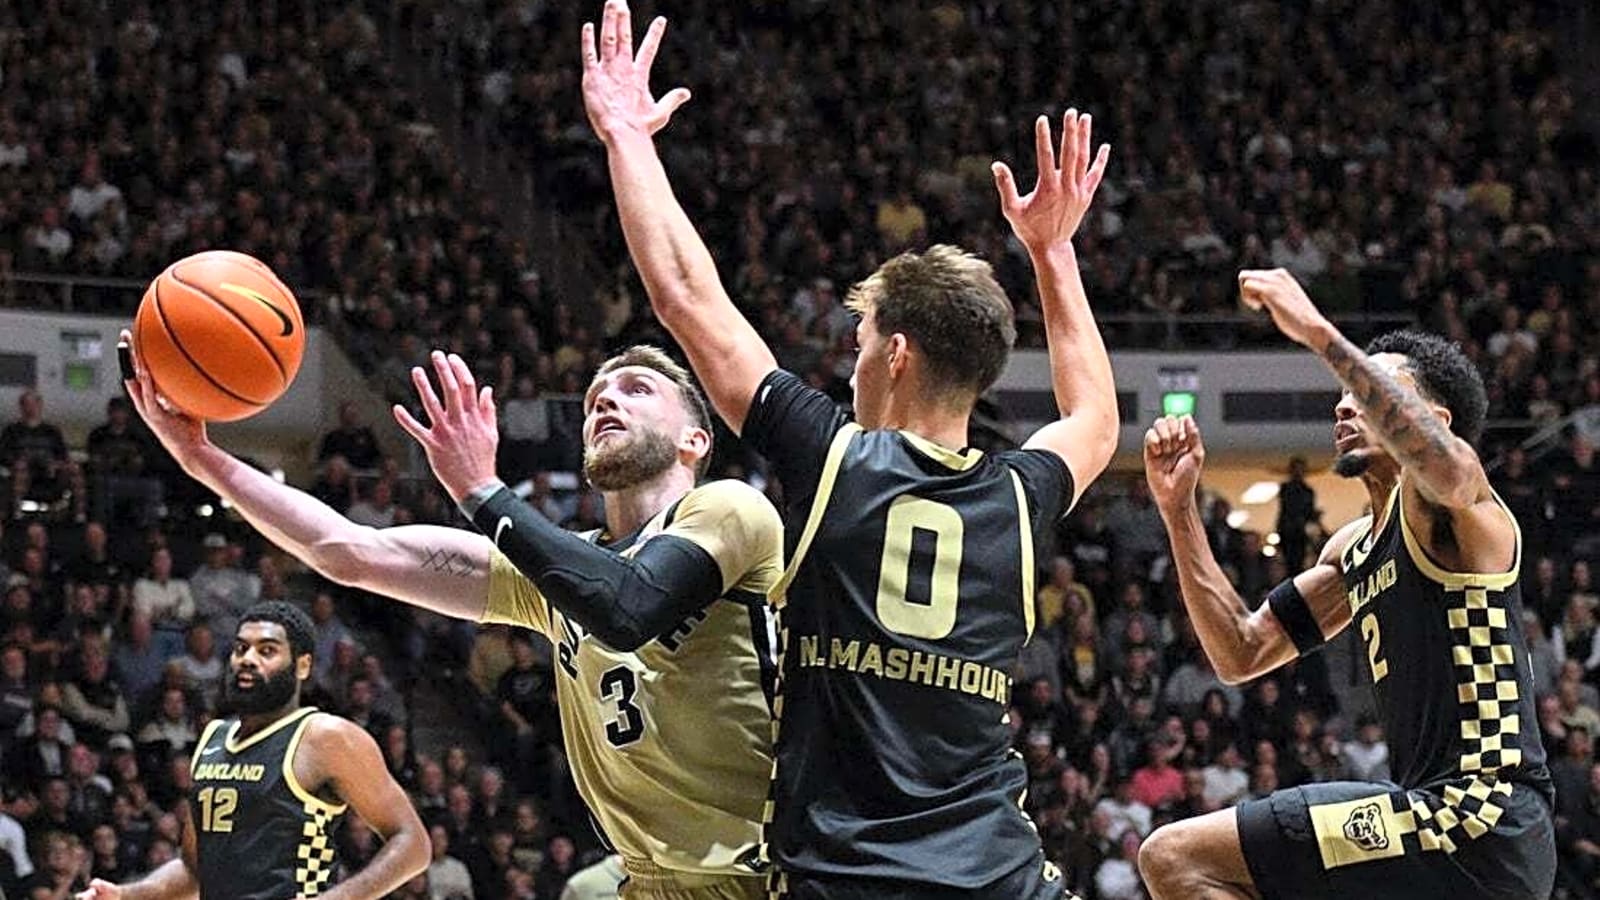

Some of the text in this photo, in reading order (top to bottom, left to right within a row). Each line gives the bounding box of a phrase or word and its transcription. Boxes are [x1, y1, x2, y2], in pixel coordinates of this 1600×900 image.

[876, 494, 964, 640] 0
[1361, 612, 1389, 682] 2
[601, 664, 644, 748] 3
[194, 762, 265, 781] OAKLAND
[198, 787, 238, 832] 12
